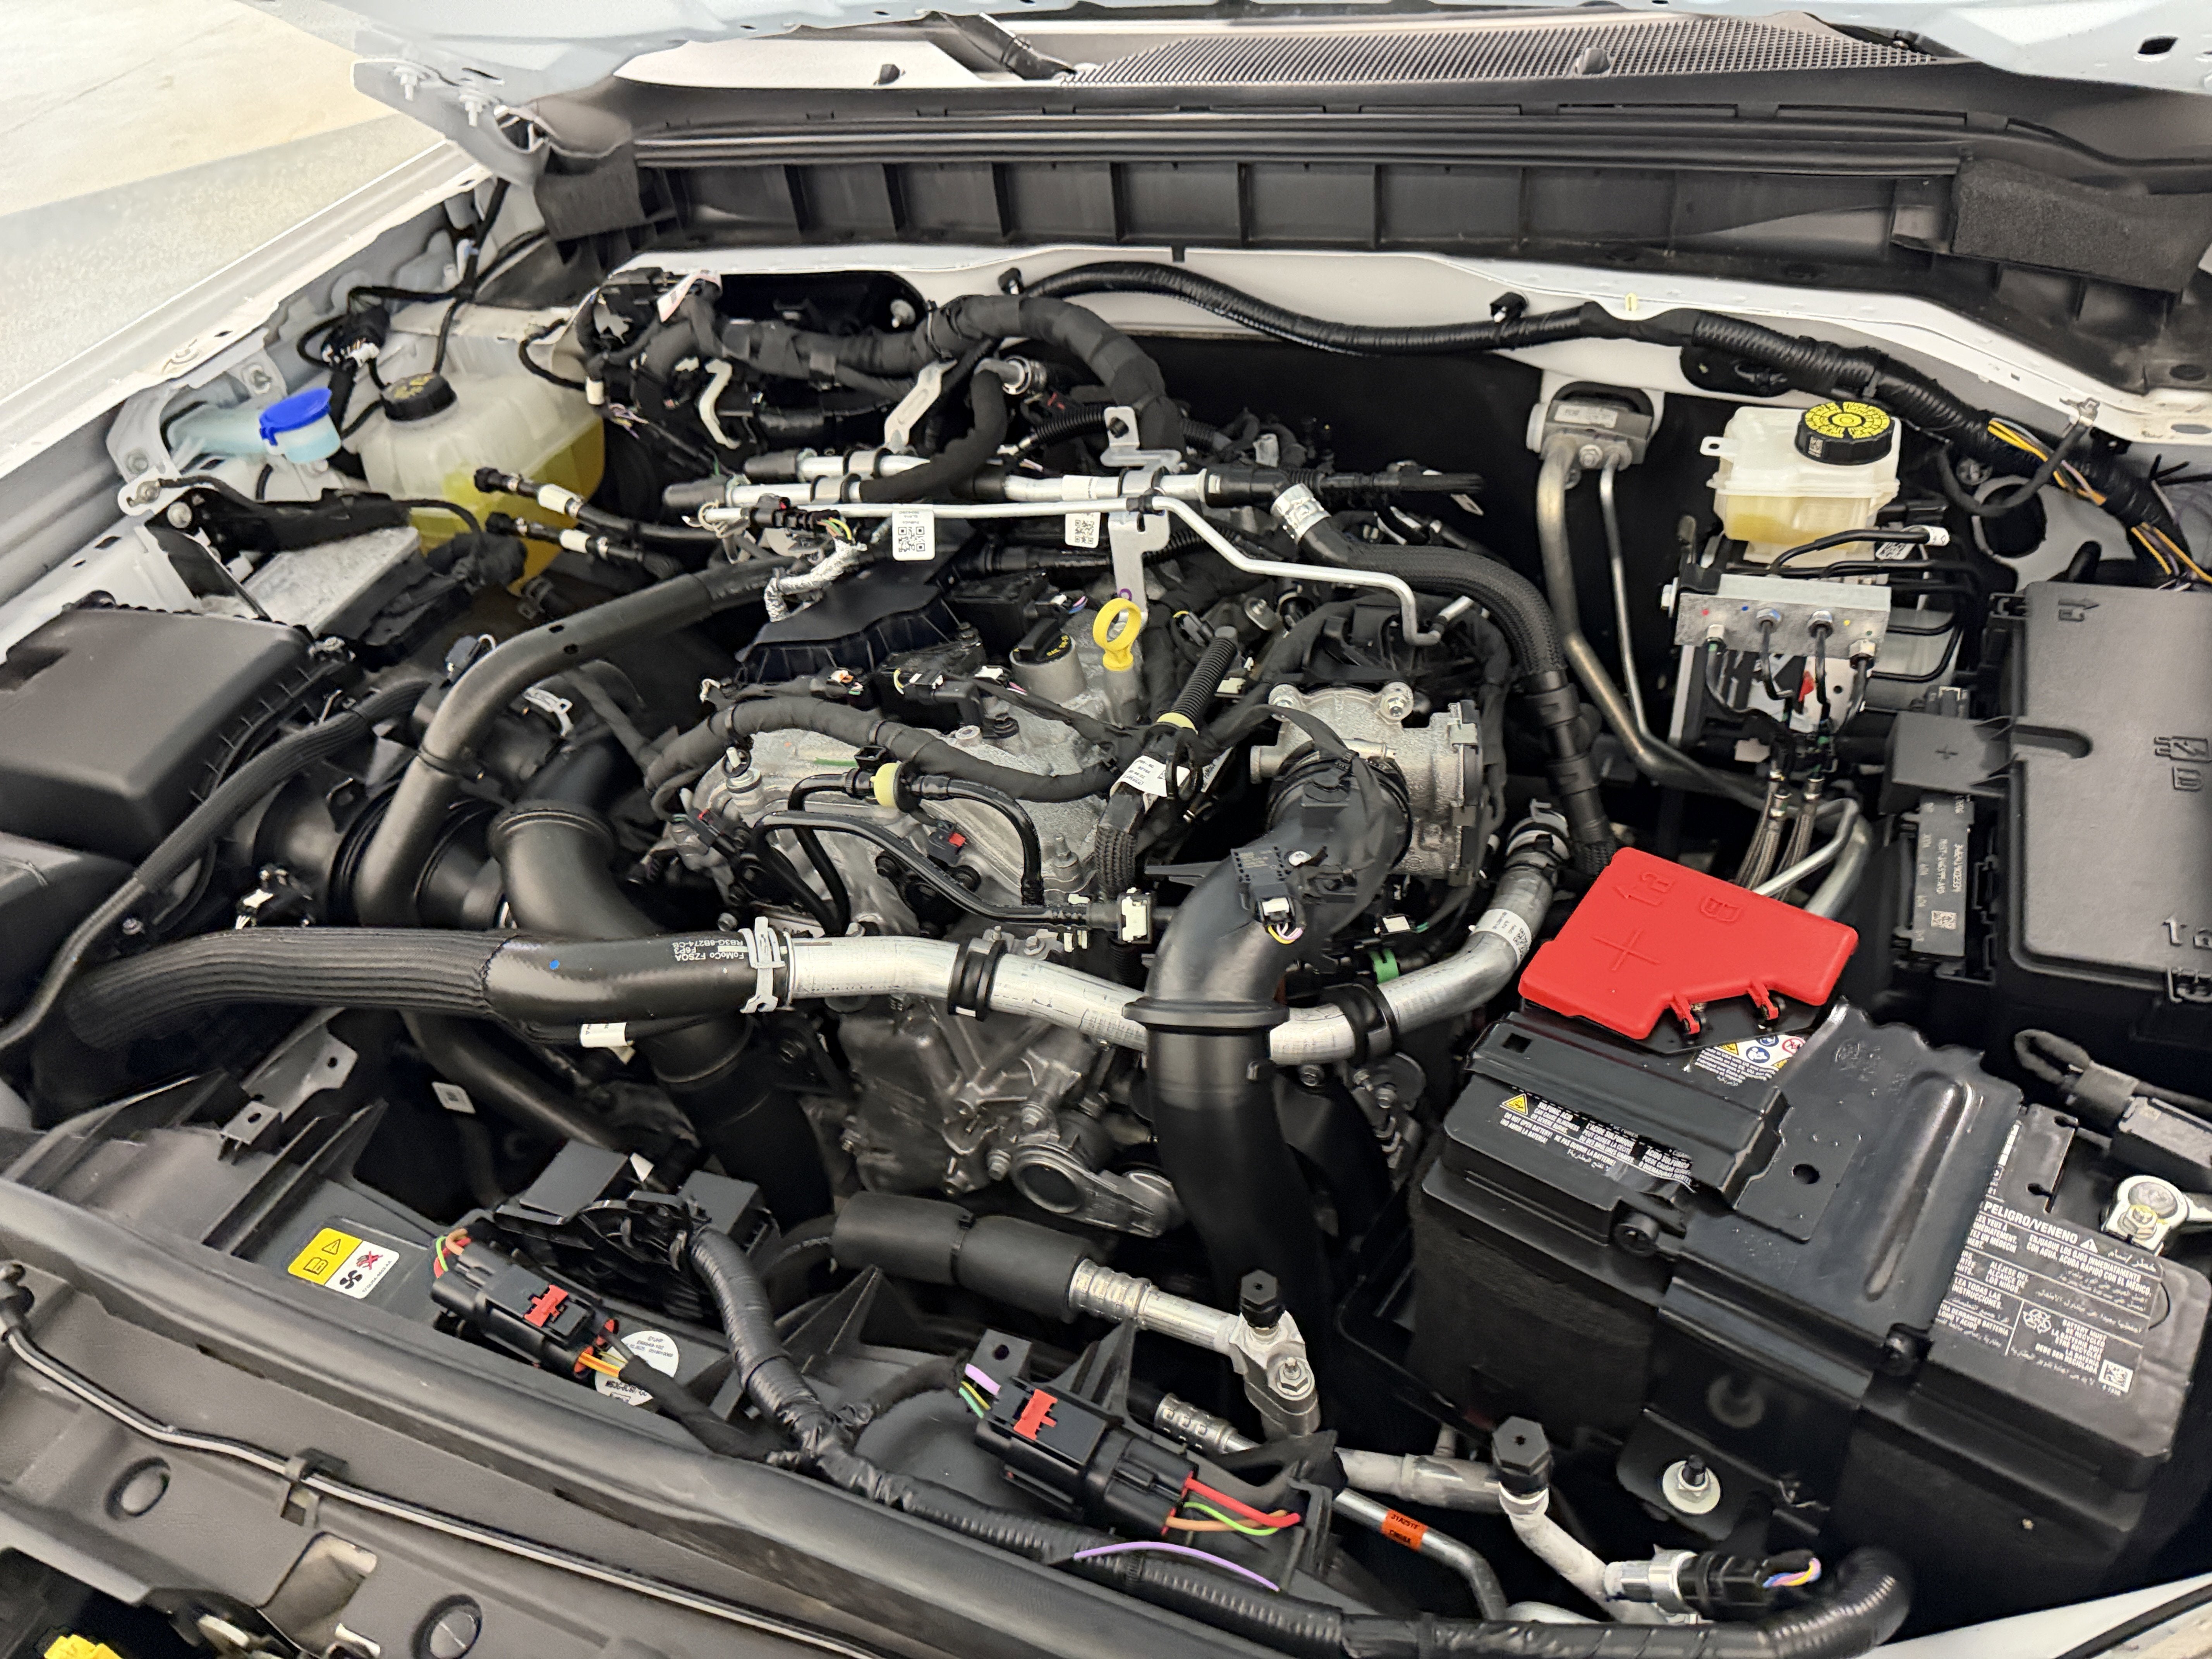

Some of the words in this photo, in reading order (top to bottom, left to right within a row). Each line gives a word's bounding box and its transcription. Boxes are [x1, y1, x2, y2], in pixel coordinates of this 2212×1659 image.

[709, 951, 744, 960] FoMoCo
[1534, 1107, 1544, 1116] CAN
[1542, 1111, 1557, 1122] CAUSE
[1556, 1117, 1580, 1132] BLINDNESS
[1537, 1100, 1562, 1117] SULFURIC
[1559, 1110, 1573, 1122] ACID
[1504, 1111, 1512, 1120] DO
[1510, 1115, 1522, 1124] NOT
[1520, 1119, 1533, 1129] OPEN
[1531, 1124, 1553, 1139] BATTERY!
[1508, 1121, 1523, 1133] ABRIR
[1521, 1127, 1528, 1135] LA
[1530, 1112, 1538, 1120] OR
[1537, 1115, 1554, 1127] SEVERE
[1552, 1122, 1569, 1134] BURNS.
[1582, 1128, 1594, 1139] PEUT
[1593, 1133, 1611, 1146] CAUSER
[1585, 1122, 1606, 1136] L'ACIDE
[1604, 1130, 1635, 1149] SULFURIQUE
[1585, 1137, 1595, 1146] DES
[1554, 1134, 1562, 1142] NE
[1560, 1137, 1571, 1146] PAS
[1570, 1141, 1588, 1154] OUVRIR
[1592, 1151, 1616, 1167] BATTERIE!
[1642, 1154, 1657, 1166] PUEDE
[1656, 1160, 1675, 1174] CAUSAR
[1642, 1161, 1673, 1180] QUEMADURAS
[1982, 1200, 2079, 1246] PELIGRO/VENENO
[1986, 1218, 2003, 1230] YEUX
[1980, 1233, 1990, 1242] UN
[2025, 1242, 2040, 1254] CON
[2058, 1254, 2080, 1269] ACUDA
[2103, 1271, 2117, 1283] CON
[2116, 1276, 2126, 1286] EL
[2028, 1233, 2060, 1252] ENJUAGUE
[2059, 1245, 2072, 1256] LOS
[2071, 1250, 2088, 1262] OJOS
[2087, 1256, 2142, 1283] INMEDIATAMENTE
[1985, 1274, 1999, 1285] LOS
[1987, 1267, 2016, 1284] ALCANCE
[2016, 1279, 2026, 1288] DE
[1989, 1259, 2017, 1277] ALÉJESE
[2016, 1271, 2030, 1282] DEL
[1954, 1277, 1967, 1287] LEA
[1966, 1281, 1988, 1295] TODAS
[1988, 1290, 2002, 1301] LAS
[1951, 1308, 1982, 1325] DERRAMES
[2061, 1319, 2089, 1335] BATTERY
[2089, 1329, 2107, 1341] MUST
[2064, 1327, 2074, 1335] BE
[2073, 1331, 2106, 1348] RECYCLED
[2050, 1328, 2059, 1337] LA
[2059, 1332, 2088, 1348] BATTERIE
[2088, 1344, 2104, 1355] DOIT
[2064, 1348, 2074, 1357] LA
[2034, 1343, 2052, 1356] DEBE
[2051, 1349, 2065, 1361] SER
[2063, 1355, 2099, 1375] RECICLADA
